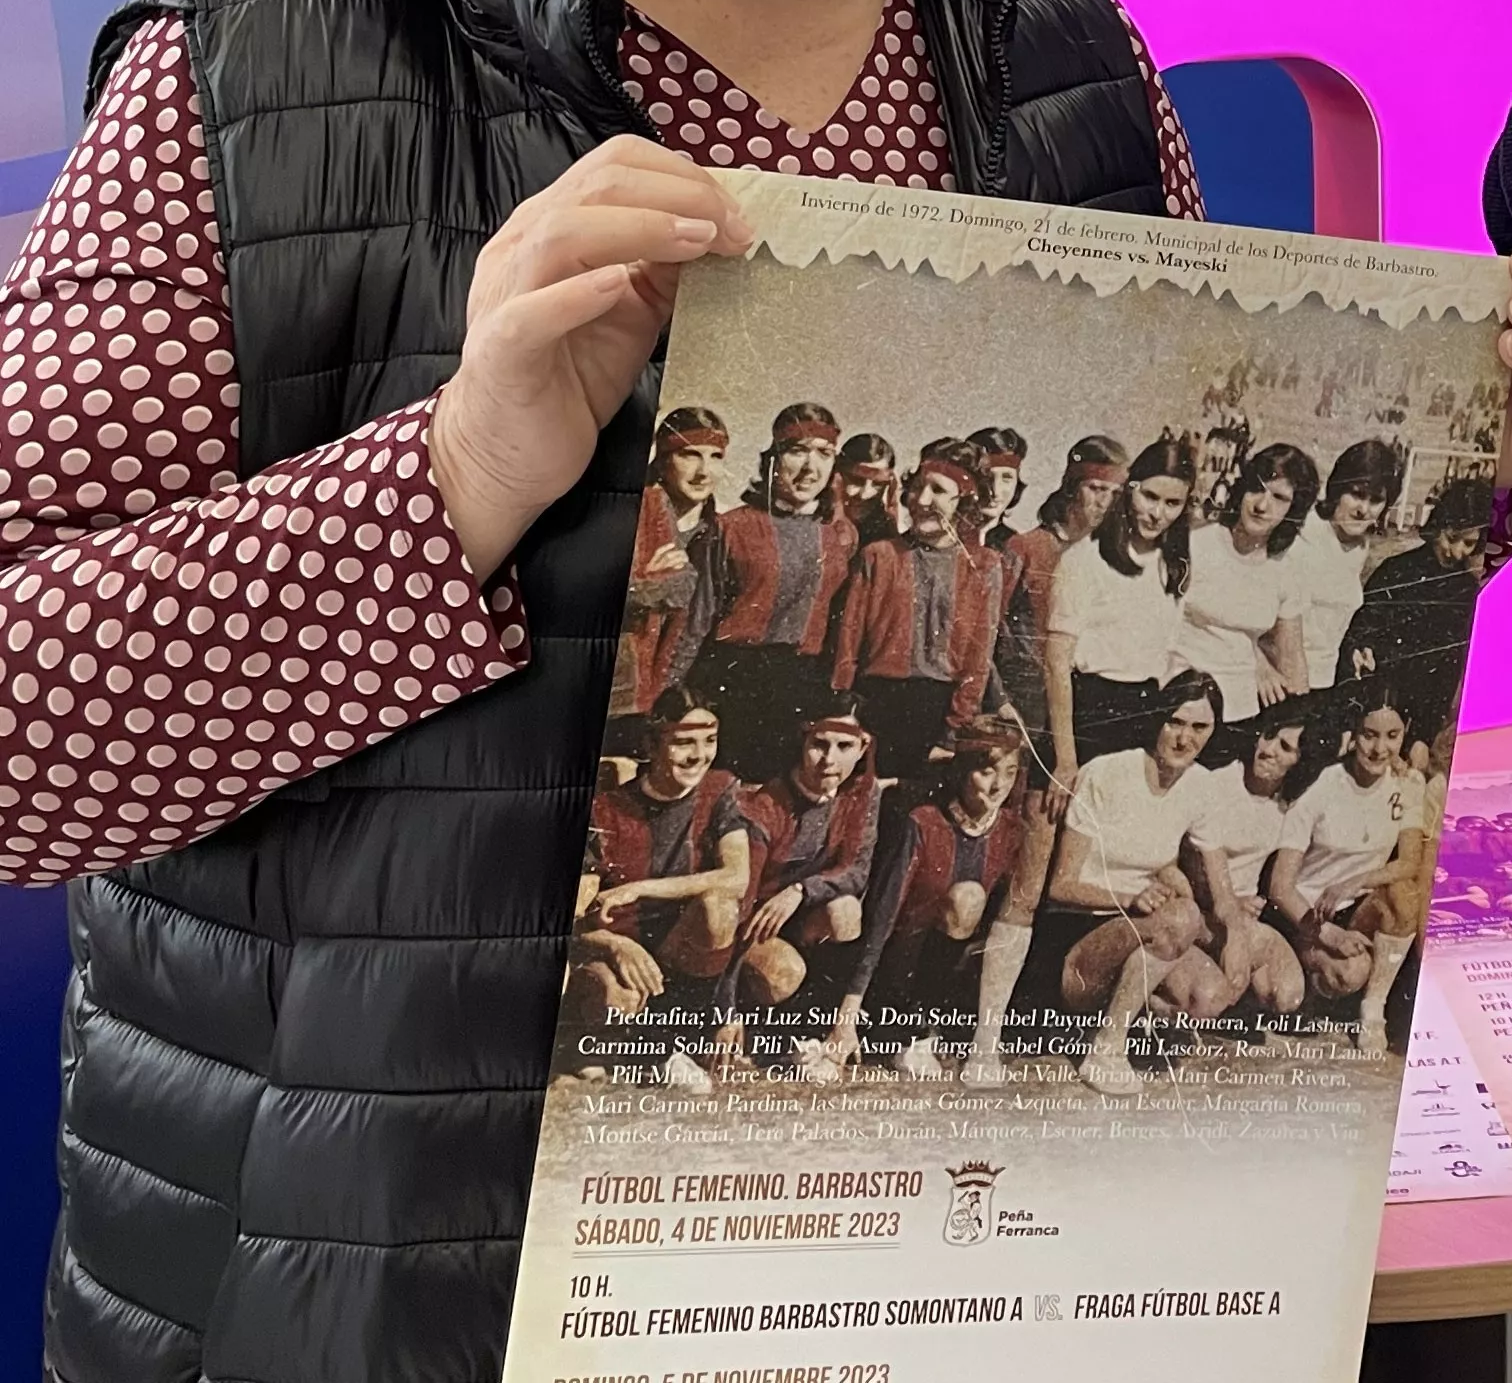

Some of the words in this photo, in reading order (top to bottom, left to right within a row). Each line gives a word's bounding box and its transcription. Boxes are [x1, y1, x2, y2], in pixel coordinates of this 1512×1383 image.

[801, 192, 870, 214] Invierno
[875, 202, 894, 216] de
[902, 204, 944, 221] 1972.
[949, 209, 1027, 233] Domingo,
[1033, 220, 1050, 233] 21
[1057, 221, 1075, 236] de
[1080, 222, 1138, 245] febrero.
[1145, 231, 1221, 253] Municipal
[1226, 240, 1243, 255] de
[1248, 243, 1268, 258] los
[1273, 245, 1339, 266] Deportes
[1344, 256, 1360, 269] de
[1366, 256, 1438, 278] Barbastro.
[1027, 237, 1123, 261] Cheyennes
[1128, 252, 1149, 264] vs.
[1156, 252, 1227, 273] Mayeski
[581, 1171, 665, 1205] FÚTBOL
[671, 1175, 789, 1203] FEMENINO.
[796, 1170, 923, 1199] BARBASTRO
[574, 1214, 664, 1247] SÁBADO,
[671, 1218, 684, 1243] 4
[691, 1216, 716, 1242] DE
[722, 1213, 843, 1242] NOVIEMBRE
[847, 1212, 900, 1237] 2023
[996, 1224, 1059, 1237] Ferranca
[999, 1210, 1033, 1222] Peña
[570, 1276, 590, 1298] 10
[595, 1275, 613, 1297] H.
[561, 1307, 640, 1339] FÚTBOL
[646, 1306, 753, 1335] FEMENINO
[759, 1302, 879, 1331] BARBASTRO
[885, 1297, 1004, 1326] SOMONTANO
[1010, 1297, 1023, 1322] A
[1034, 1295, 1063, 1321] VS.
[1074, 1293, 1135, 1319] FRAGA
[1141, 1288, 1210, 1318] FÚTBOL
[1216, 1292, 1264, 1316] BASE
[1268, 1291, 1280, 1315] A
[838, 1364, 890, 1383] 2023
